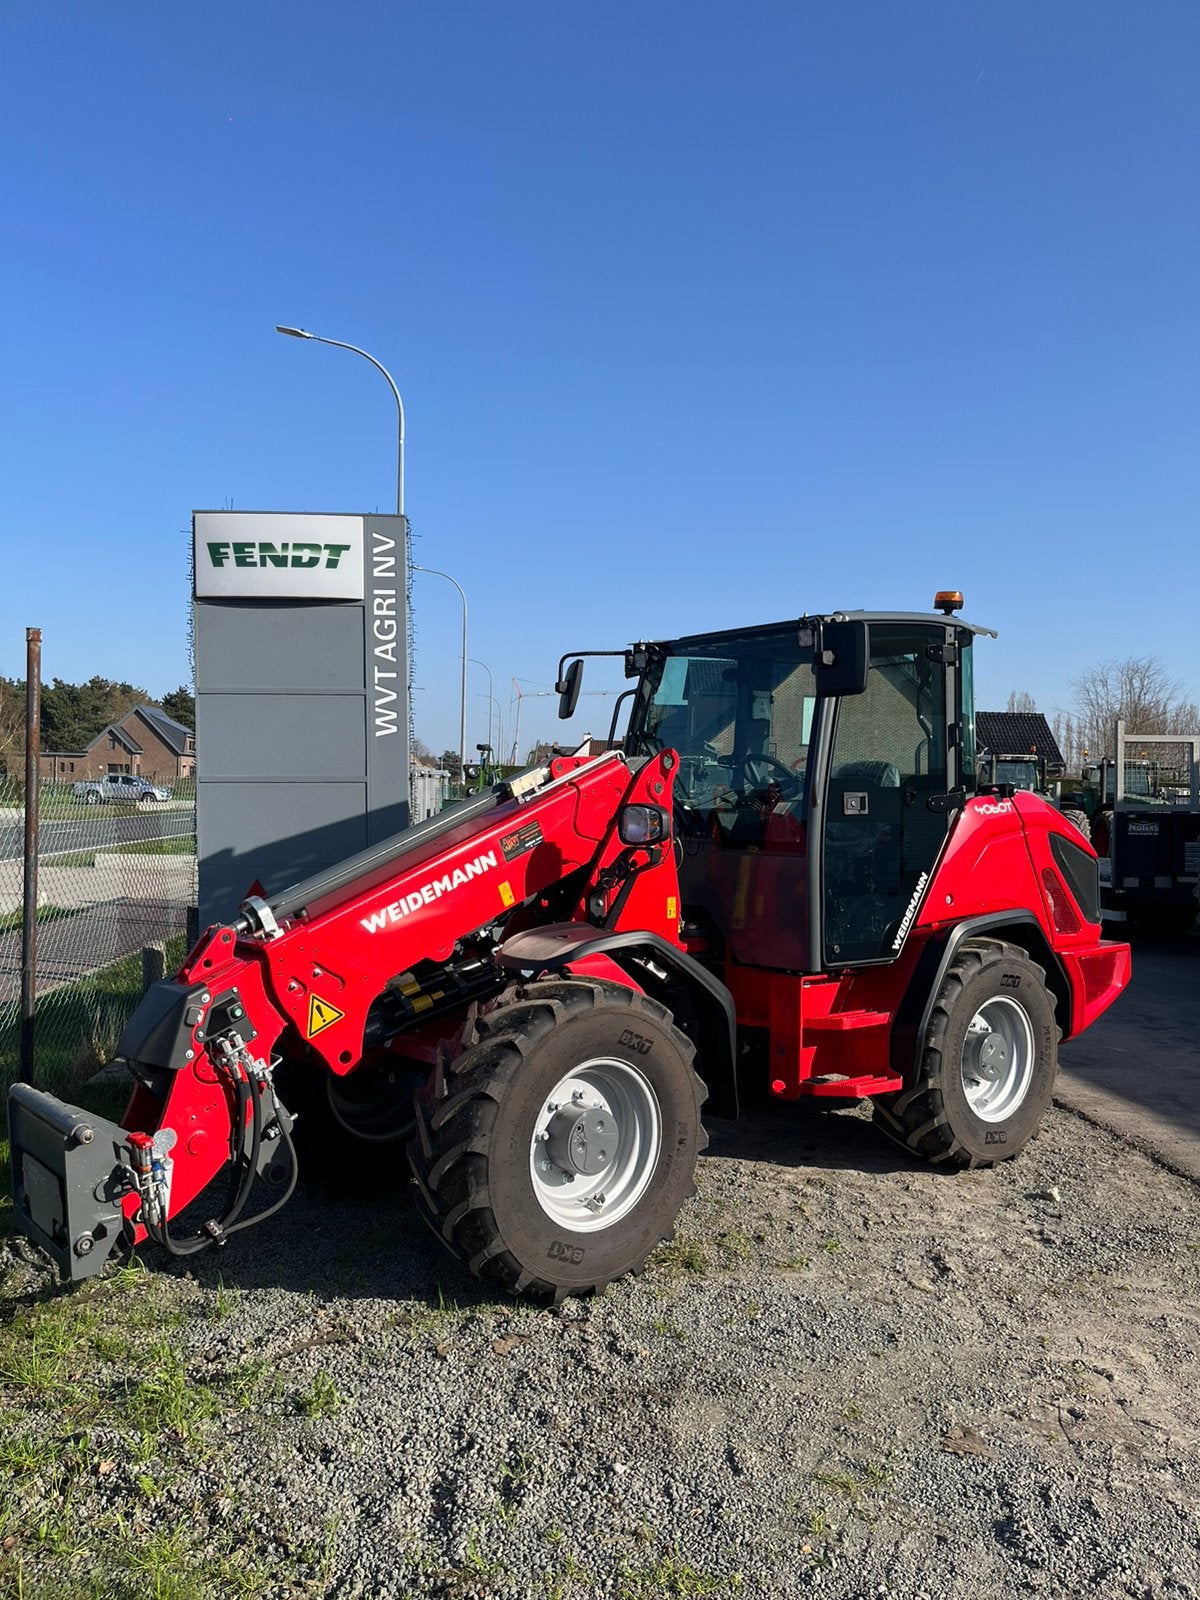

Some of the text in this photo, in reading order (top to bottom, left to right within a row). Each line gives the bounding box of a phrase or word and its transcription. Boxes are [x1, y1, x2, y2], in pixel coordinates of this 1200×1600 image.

[206, 542, 352, 569] FENDT
[372, 532, 398, 737] WVT AGRI NV
[974, 802, 1012, 815] 4060T
[360, 850, 498, 934] WEIDEMANN
[892, 871, 928, 950] WEIDEMANN
[1000, 973, 1021, 988] BKT
[617, 1029, 654, 1055] BKT
[985, 1131, 1006, 1145] BKT
[546, 1240, 586, 1266] BKT
